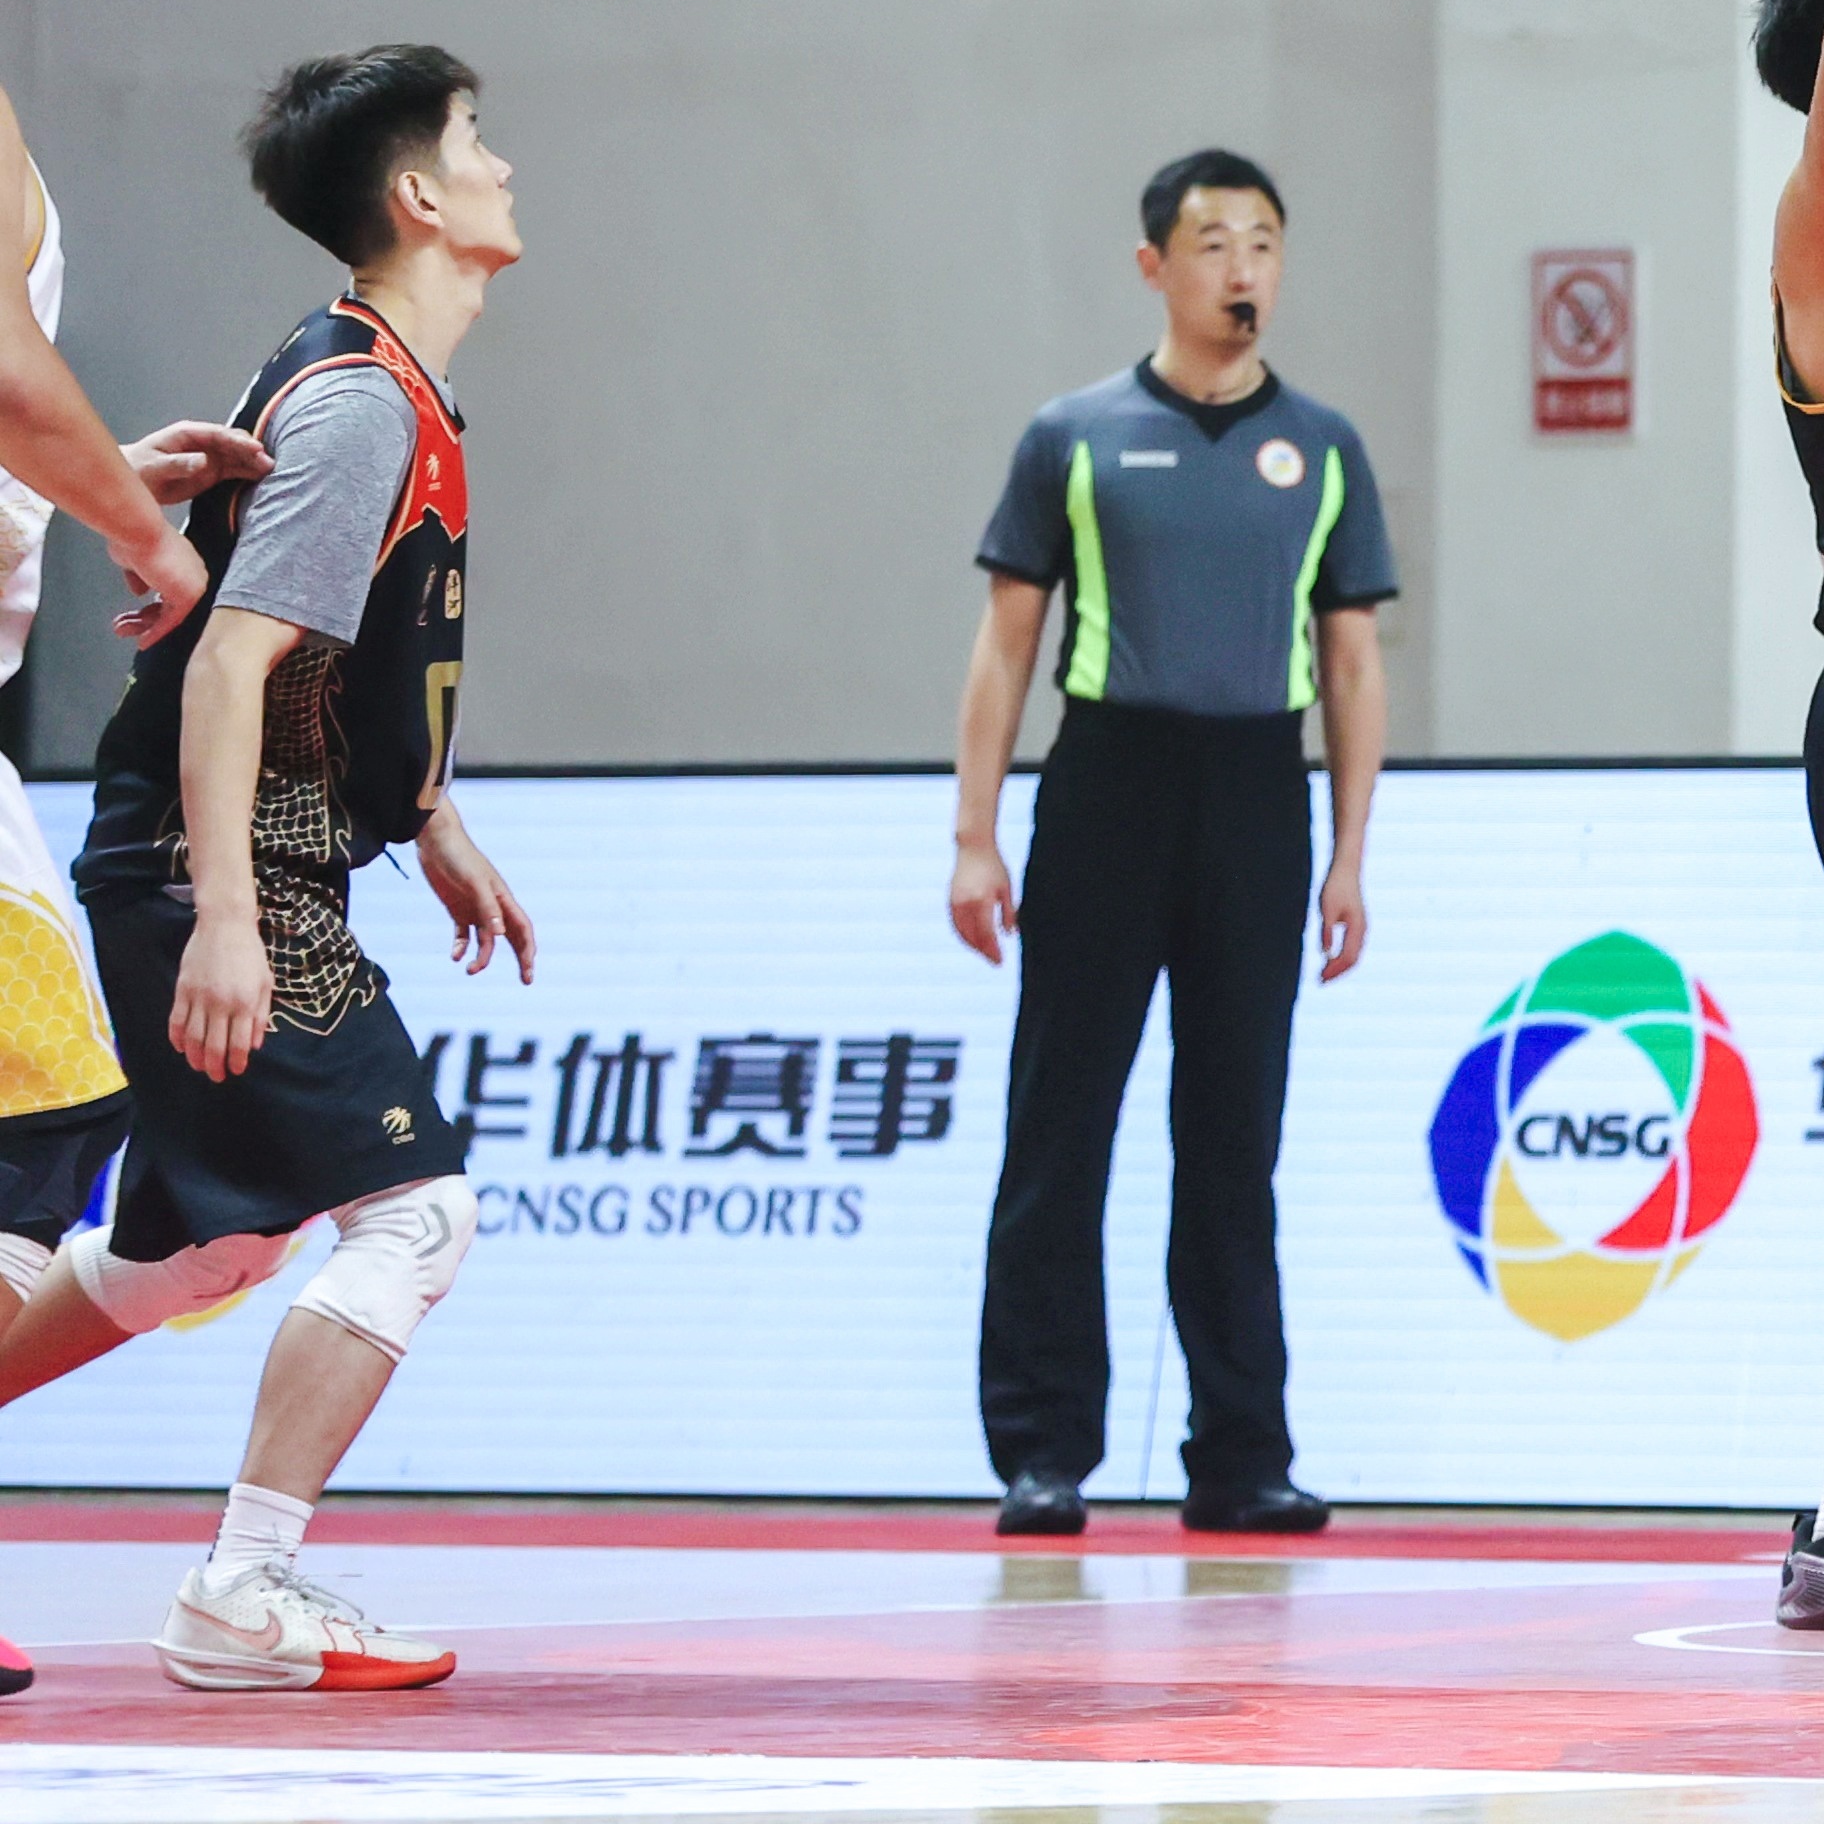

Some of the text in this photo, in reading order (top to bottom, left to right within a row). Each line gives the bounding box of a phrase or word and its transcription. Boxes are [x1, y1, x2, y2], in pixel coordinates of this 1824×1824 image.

[1516, 1112, 1672, 1160] CNSG
[477, 1185, 863, 1237] CNSG SPORTS
